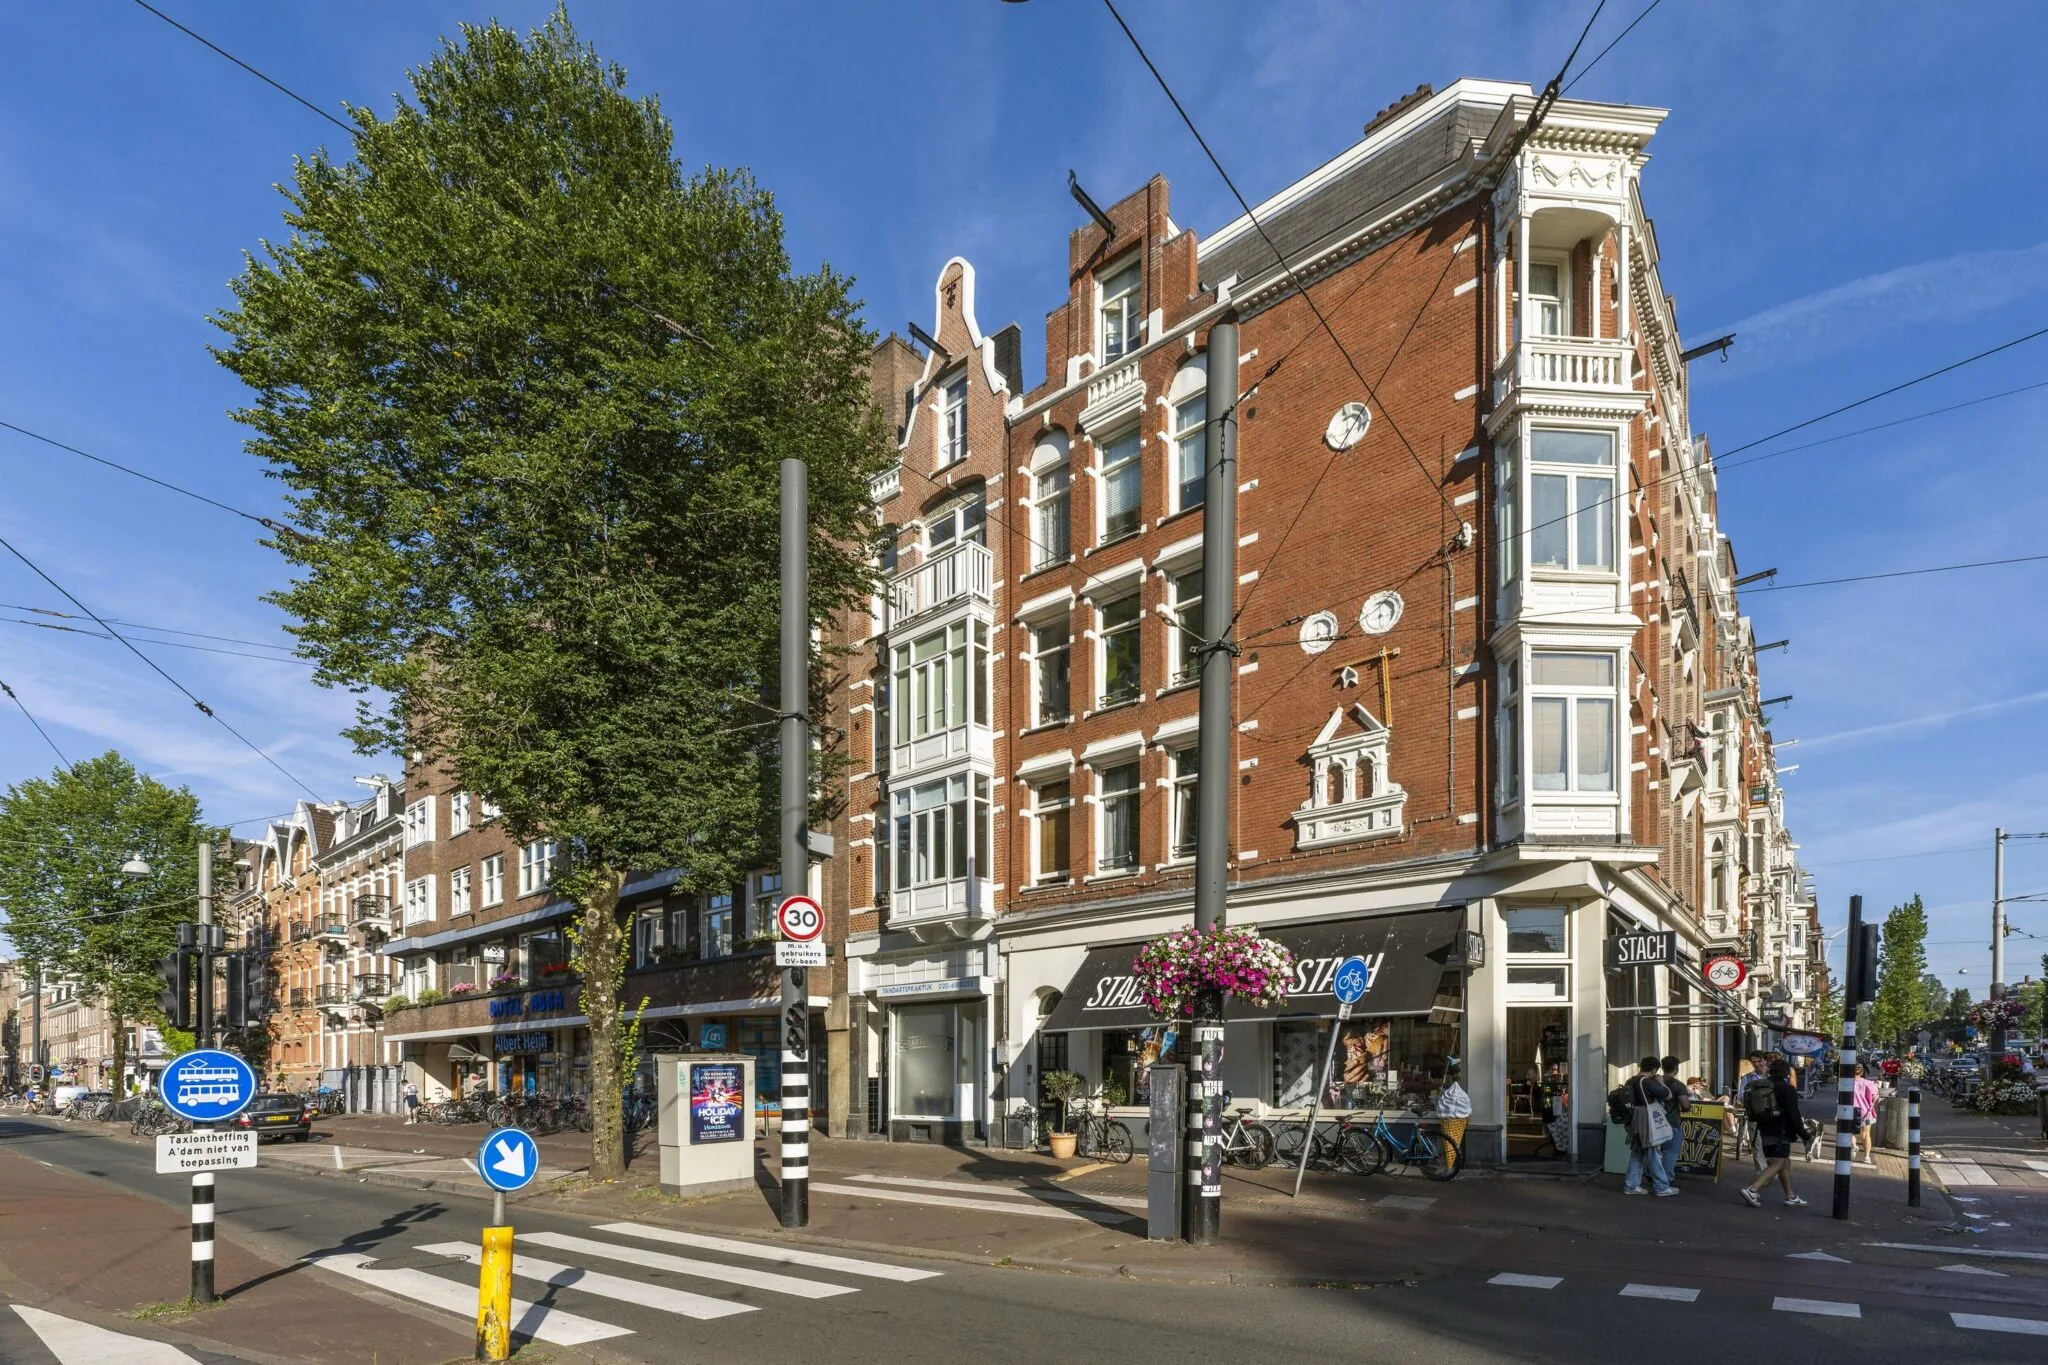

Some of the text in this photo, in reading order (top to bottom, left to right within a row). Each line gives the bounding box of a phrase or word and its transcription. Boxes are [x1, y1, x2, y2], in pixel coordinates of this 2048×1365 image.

[788, 909, 817, 928] 30
[1618, 934, 1667, 962] STACH
[1287, 953, 1385, 994] STAH
[882, 984, 933, 995] TANDARTSPRAKTIJK
[1087, 976, 1145, 1007] STAC
[531, 992, 564, 1013] ABBA
[495, 1031, 548, 1052] Albert Heijn
[698, 1107, 737, 1117] HOLIDAY
[710, 1115, 726, 1125] ICE
[169, 1133, 249, 1145] Taxiontheffing
[1681, 1120, 1713, 1143] OFT
[168, 1145, 250, 1157] A'dam niet van
[180, 1156, 239, 1168] toepassing
